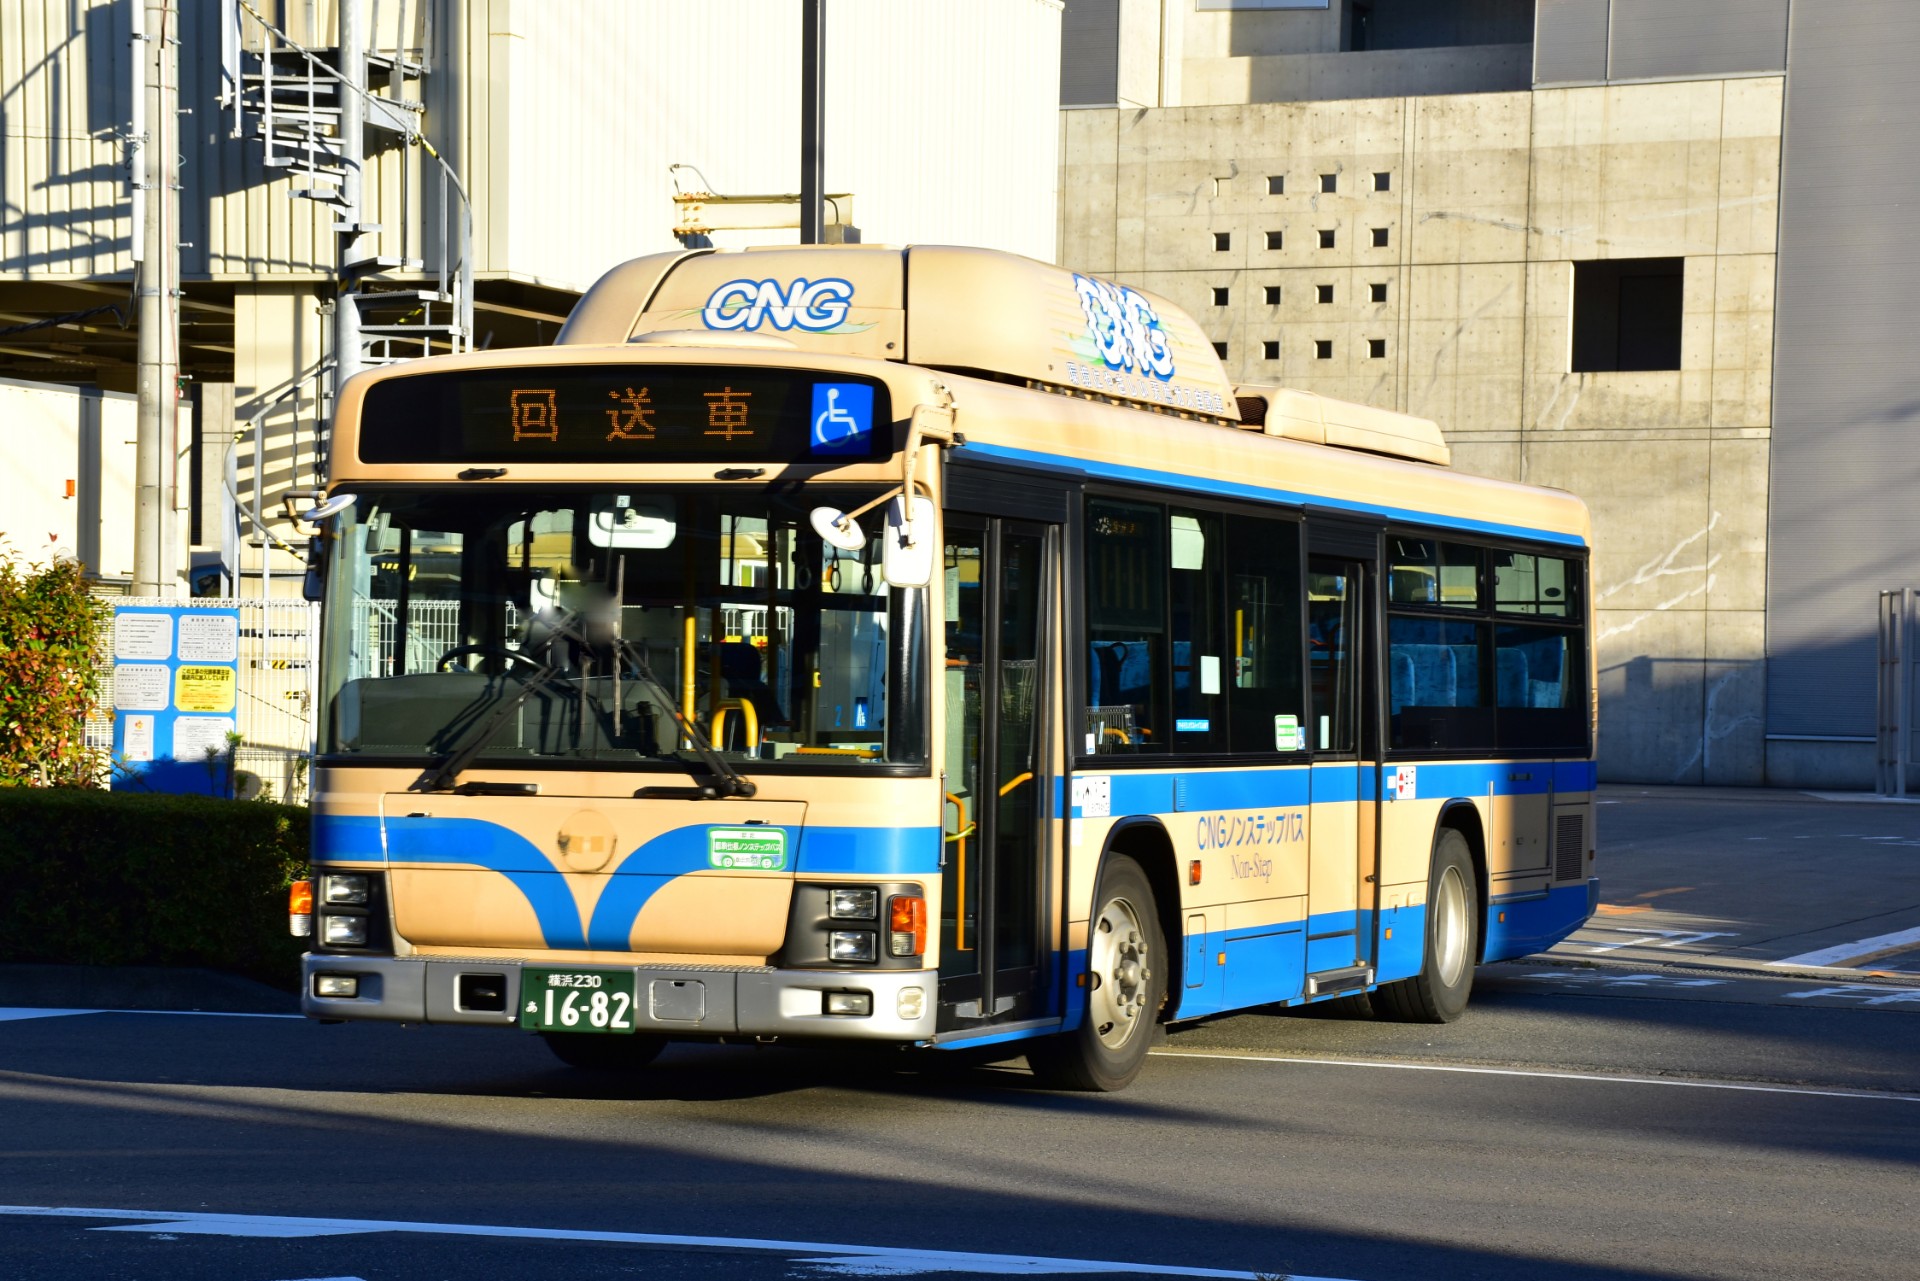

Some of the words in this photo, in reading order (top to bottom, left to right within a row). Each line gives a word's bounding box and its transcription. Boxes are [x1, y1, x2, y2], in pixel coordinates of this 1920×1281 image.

[702, 277, 854, 332] CNG
[510, 386, 754, 442] 回送車
[1197, 812, 1305, 851] CNGノンステップバス
[1231, 852, 1273, 884] Non-Step
[525, 1000, 538, 1013] あ
[544, 989, 631, 1029] 16-82
